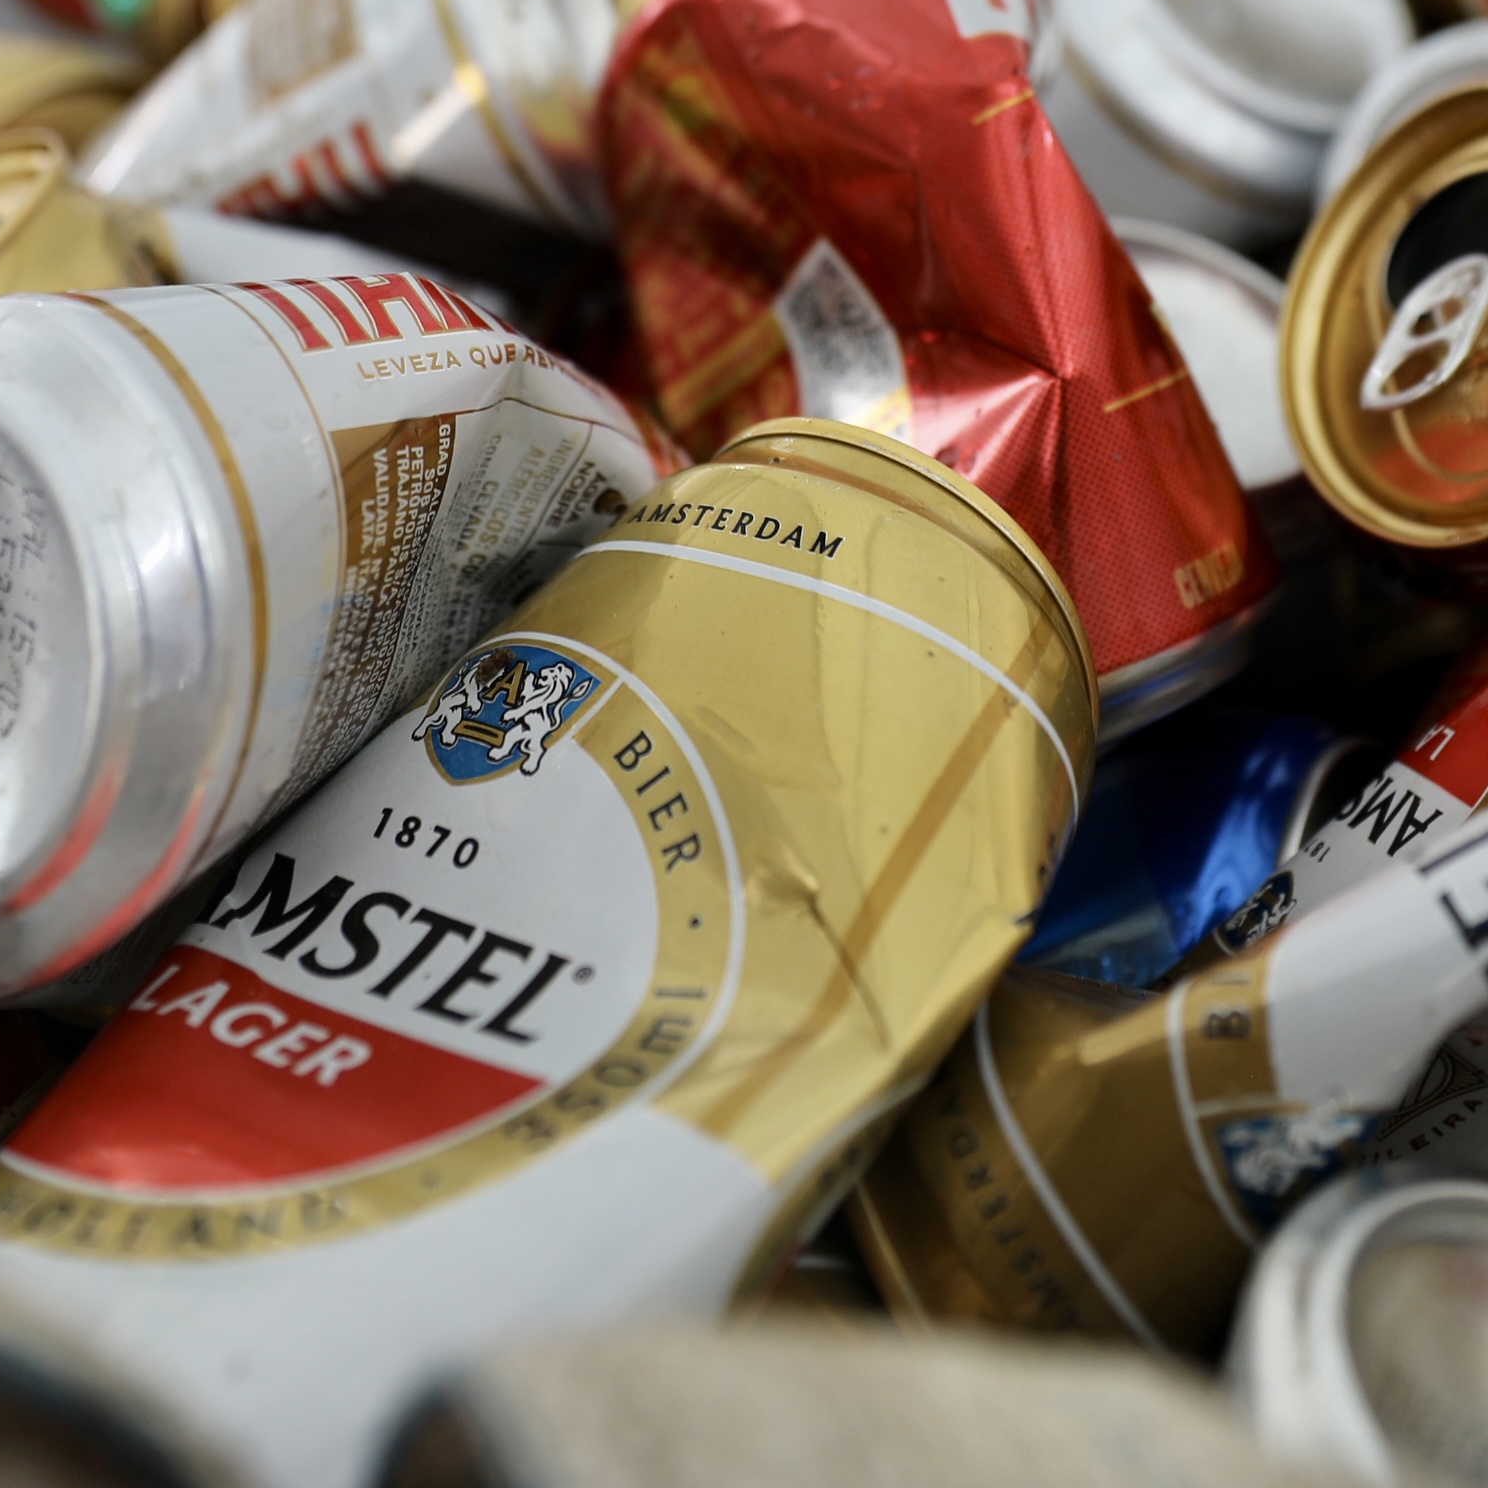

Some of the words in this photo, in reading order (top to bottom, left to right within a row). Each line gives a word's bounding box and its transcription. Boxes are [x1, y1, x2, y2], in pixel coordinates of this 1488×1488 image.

[356, 350, 462, 381] LEVEZA
[468, 342, 517, 369] QUE
[435, 424, 451, 482] GRAD.
[392, 445, 409, 538] TRAJANO
[397, 447, 424, 563] PETRÓPOLIS
[420, 469, 435, 507] SOB
[360, 499, 376, 554] LATA.
[630, 503, 845, 560] AMSTERDAM
[377, 545, 403, 606] PAULA
[612, 730, 704, 874] BIER
[370, 806, 481, 870] 1870
[128, 964, 373, 1085] LAGER
